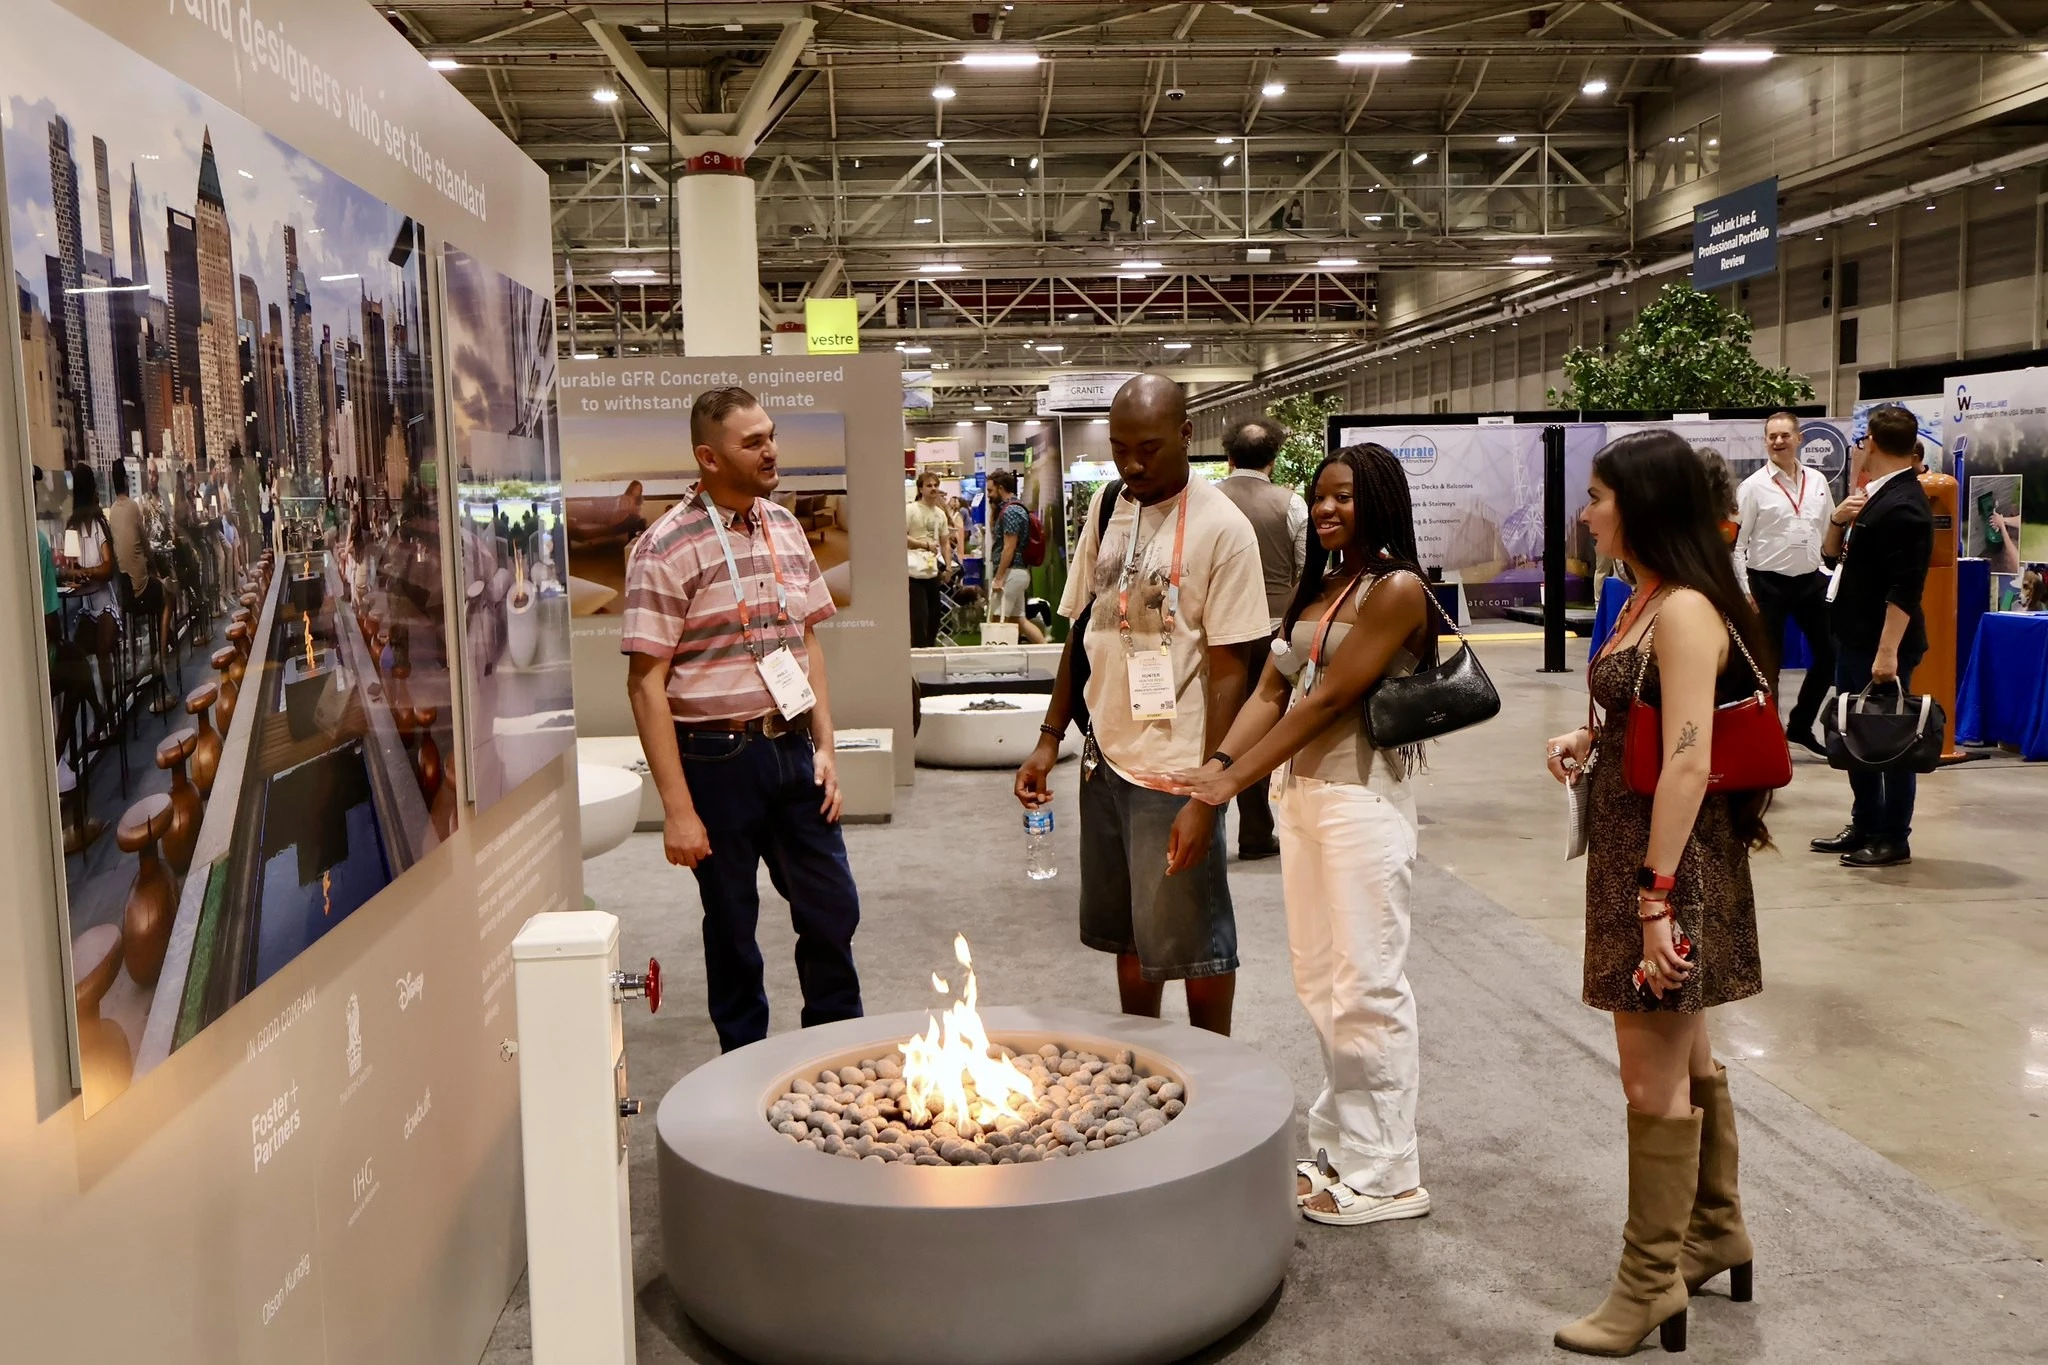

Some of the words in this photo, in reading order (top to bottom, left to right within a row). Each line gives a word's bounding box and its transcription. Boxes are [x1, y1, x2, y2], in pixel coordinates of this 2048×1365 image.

[238, 0, 342, 119] designers
[345, 84, 380, 146] who
[384, 119, 408, 168] set
[410, 131, 432, 184] the
[435, 157, 487, 222] standard
[1710, 217, 1735, 237] JobLink
[1736, 214, 1750, 228] Live
[1751, 210, 1757, 223] &
[1698, 235, 1738, 259] Professional
[1738, 226, 1769, 246] Portfolio
[1721, 254, 1745, 270] Review
[811, 334, 854, 345] vestre
[561, 371, 616, 388] urable
[621, 371, 655, 386] GFR
[660, 371, 743, 387] Concrete,
[748, 366, 843, 387] engineered
[1071, 386, 1104, 395] GRANITE
[581, 397, 599, 411] to
[604, 393, 692, 411] withstand
[1467, 599, 1509, 607] ate.com
[246, 1039, 256, 1063] IN
[258, 1018, 279, 1052] GOOD
[281, 985, 316, 1032] COMPANY
[252, 1091, 288, 1144] Foster
[254, 1109, 300, 1173] Partners
[353, 1156, 372, 1202] IHG
[263, 1288, 284, 1325] Olson
[285, 1253, 310, 1296] Kundig
